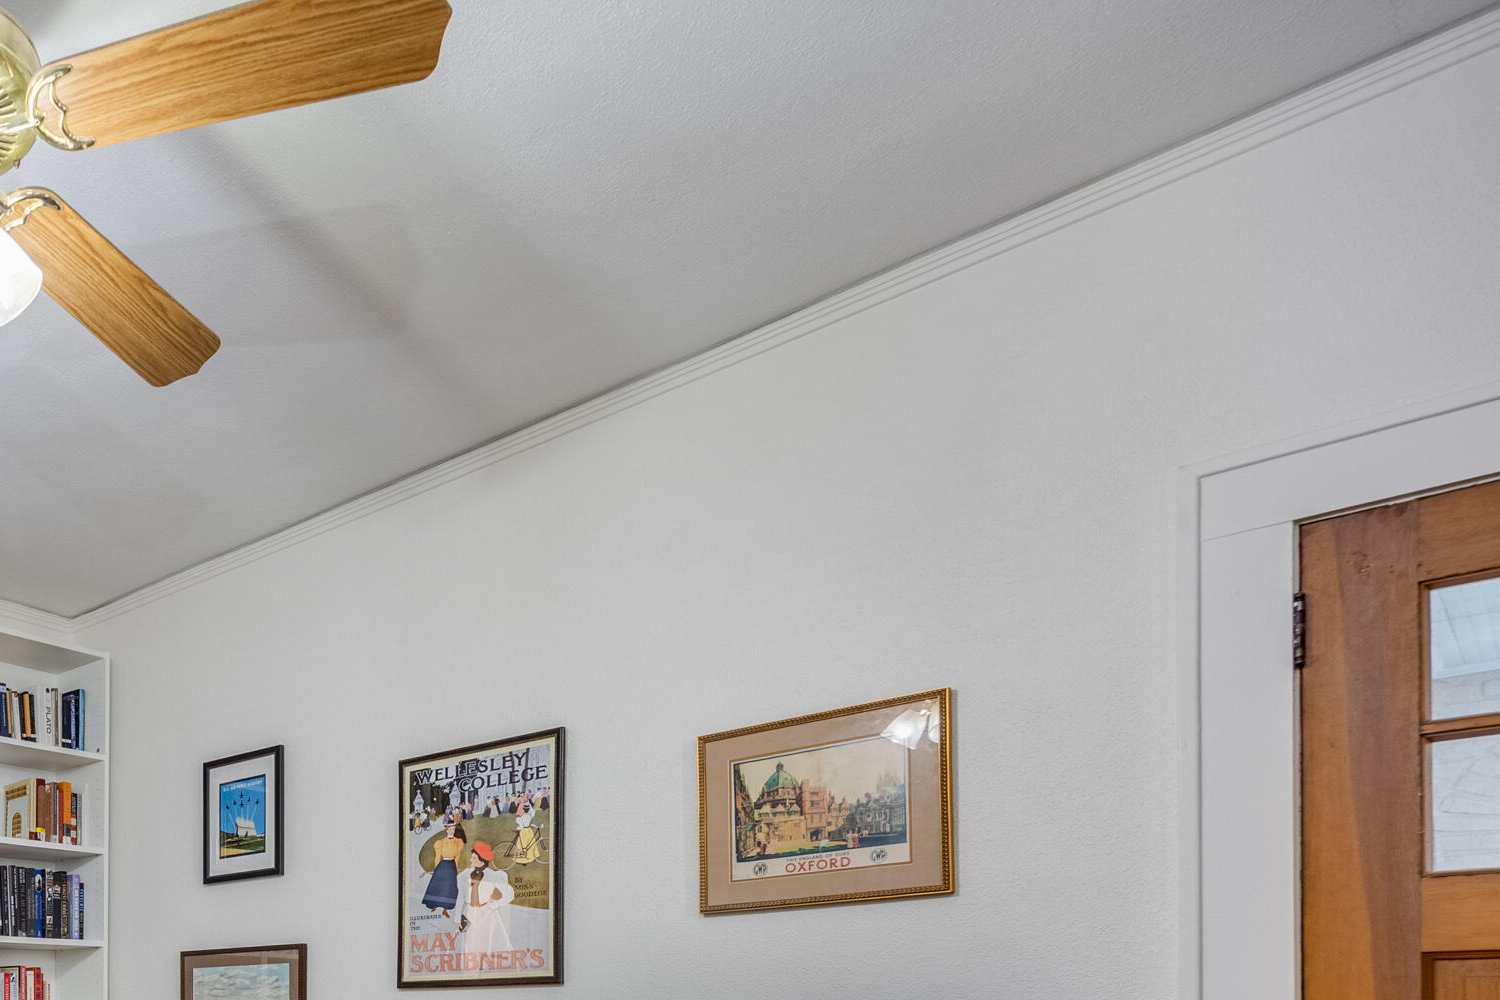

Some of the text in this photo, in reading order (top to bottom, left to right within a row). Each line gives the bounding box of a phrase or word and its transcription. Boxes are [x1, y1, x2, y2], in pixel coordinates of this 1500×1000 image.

[416, 752, 526, 785] WELLESLEY
[458, 765, 549, 792] COLLEGE
[785, 856, 851, 873] OXFORD
[514, 876, 524, 884] BY
[410, 931, 459, 953] MAY
[410, 948, 545, 973] SCRIBNER'S
